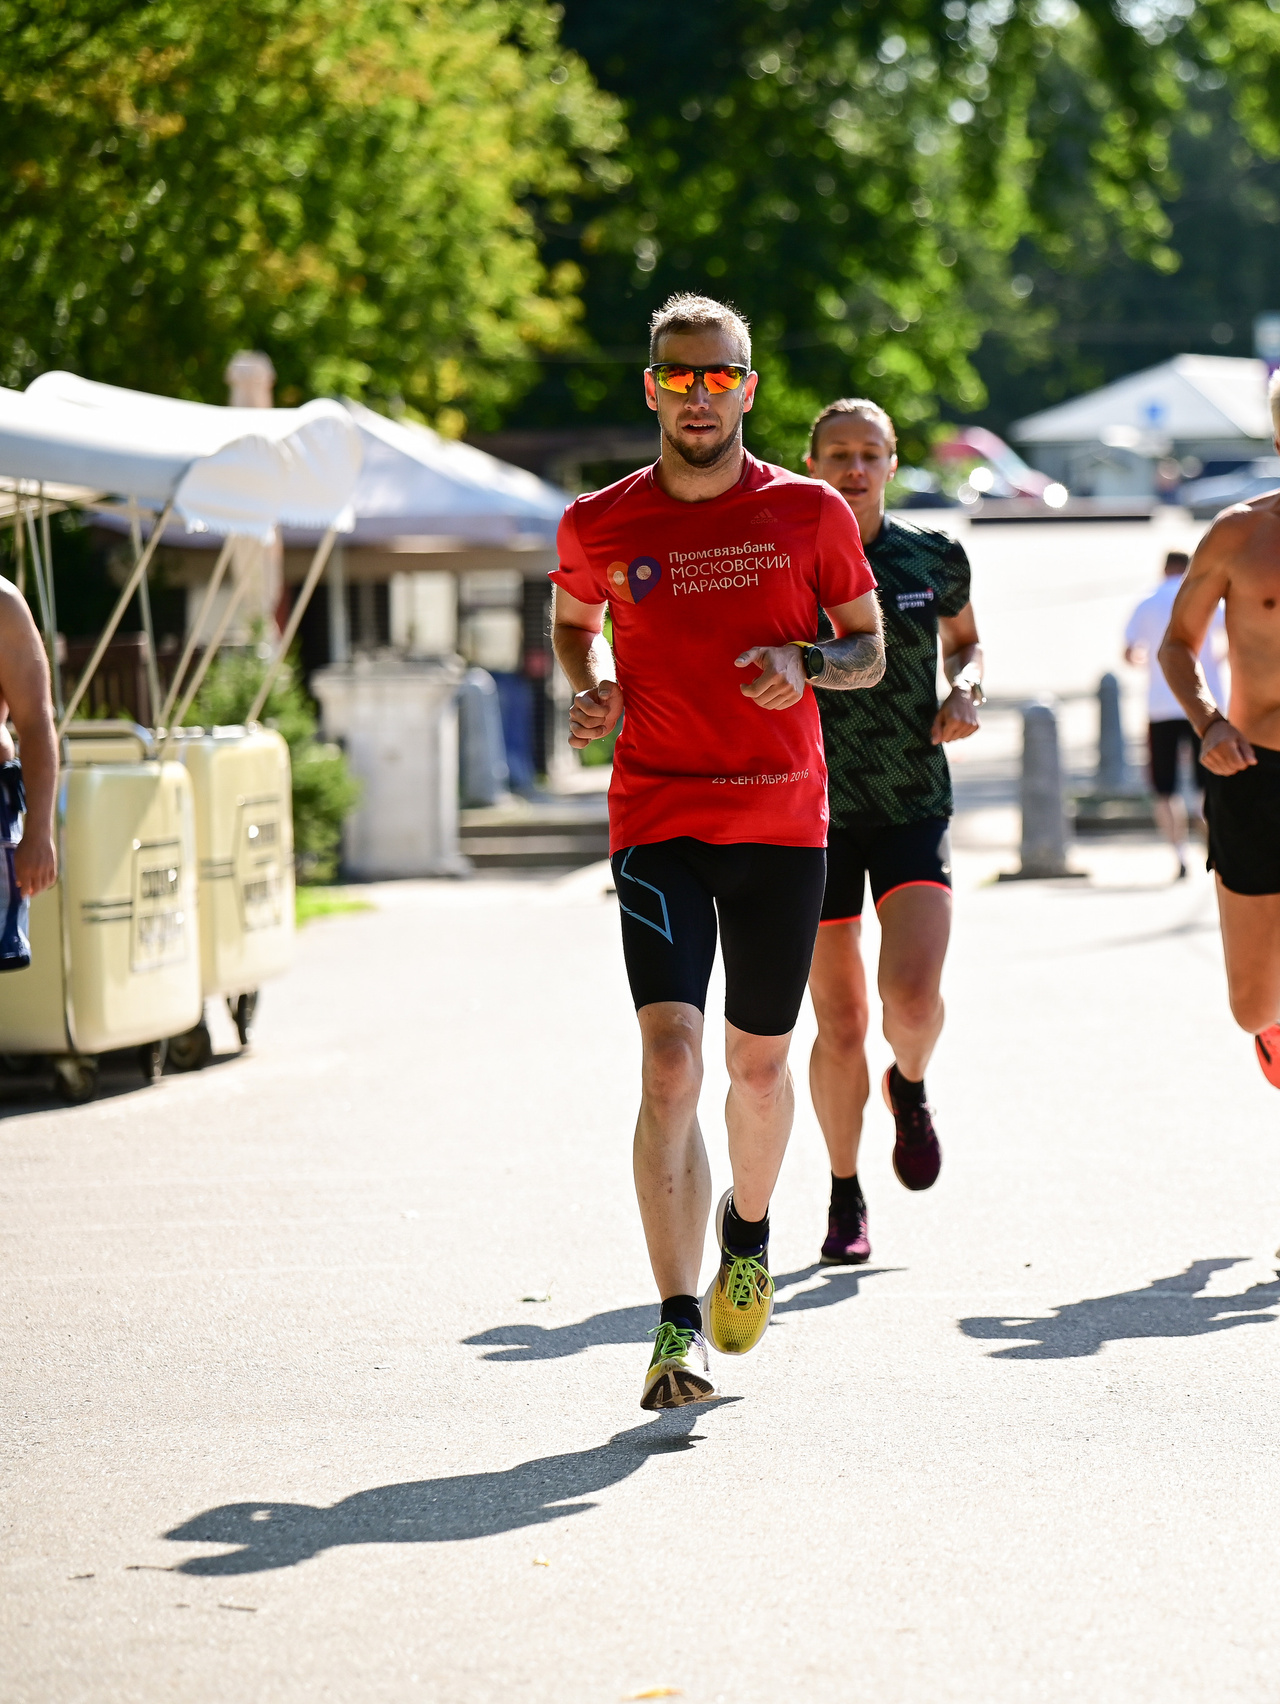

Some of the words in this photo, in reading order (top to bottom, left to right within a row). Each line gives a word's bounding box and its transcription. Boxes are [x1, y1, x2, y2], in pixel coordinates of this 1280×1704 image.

[668, 541, 776, 564] Промсвязьбанк
[670, 553, 791, 580] МОСКОВСКИЙ
[672, 573, 759, 596] МАРАФОН
[729, 773, 789, 785] СЕНТЯБРЯ
[790, 768, 809, 783] 2016
